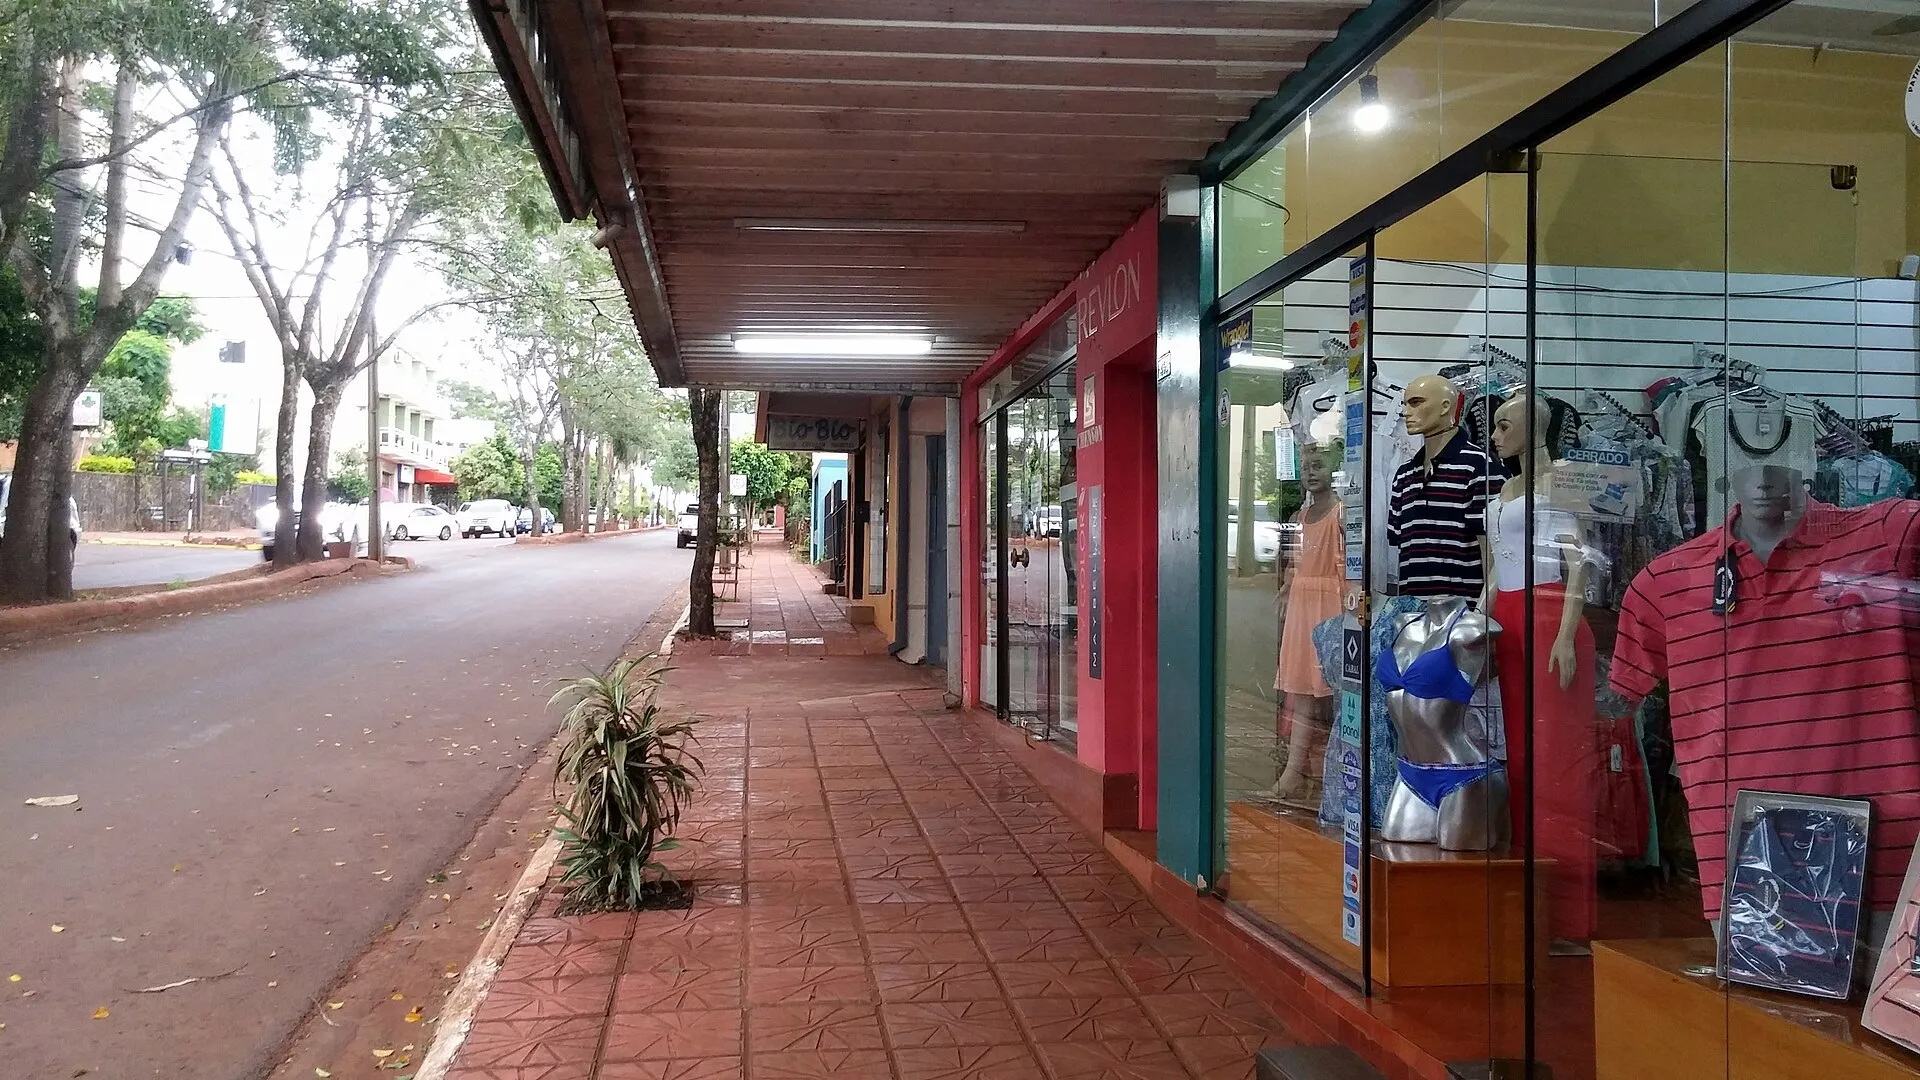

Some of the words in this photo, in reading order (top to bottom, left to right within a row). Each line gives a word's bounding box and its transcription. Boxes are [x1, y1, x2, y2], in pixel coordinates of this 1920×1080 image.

[1352, 264, 1364, 280] VISA
[1078, 251, 1140, 343] REVLON
[1221, 320, 1250, 349] Wrangler
[1567, 449, 1624, 464] CERRADO
[1347, 819, 1360, 834] VISA
